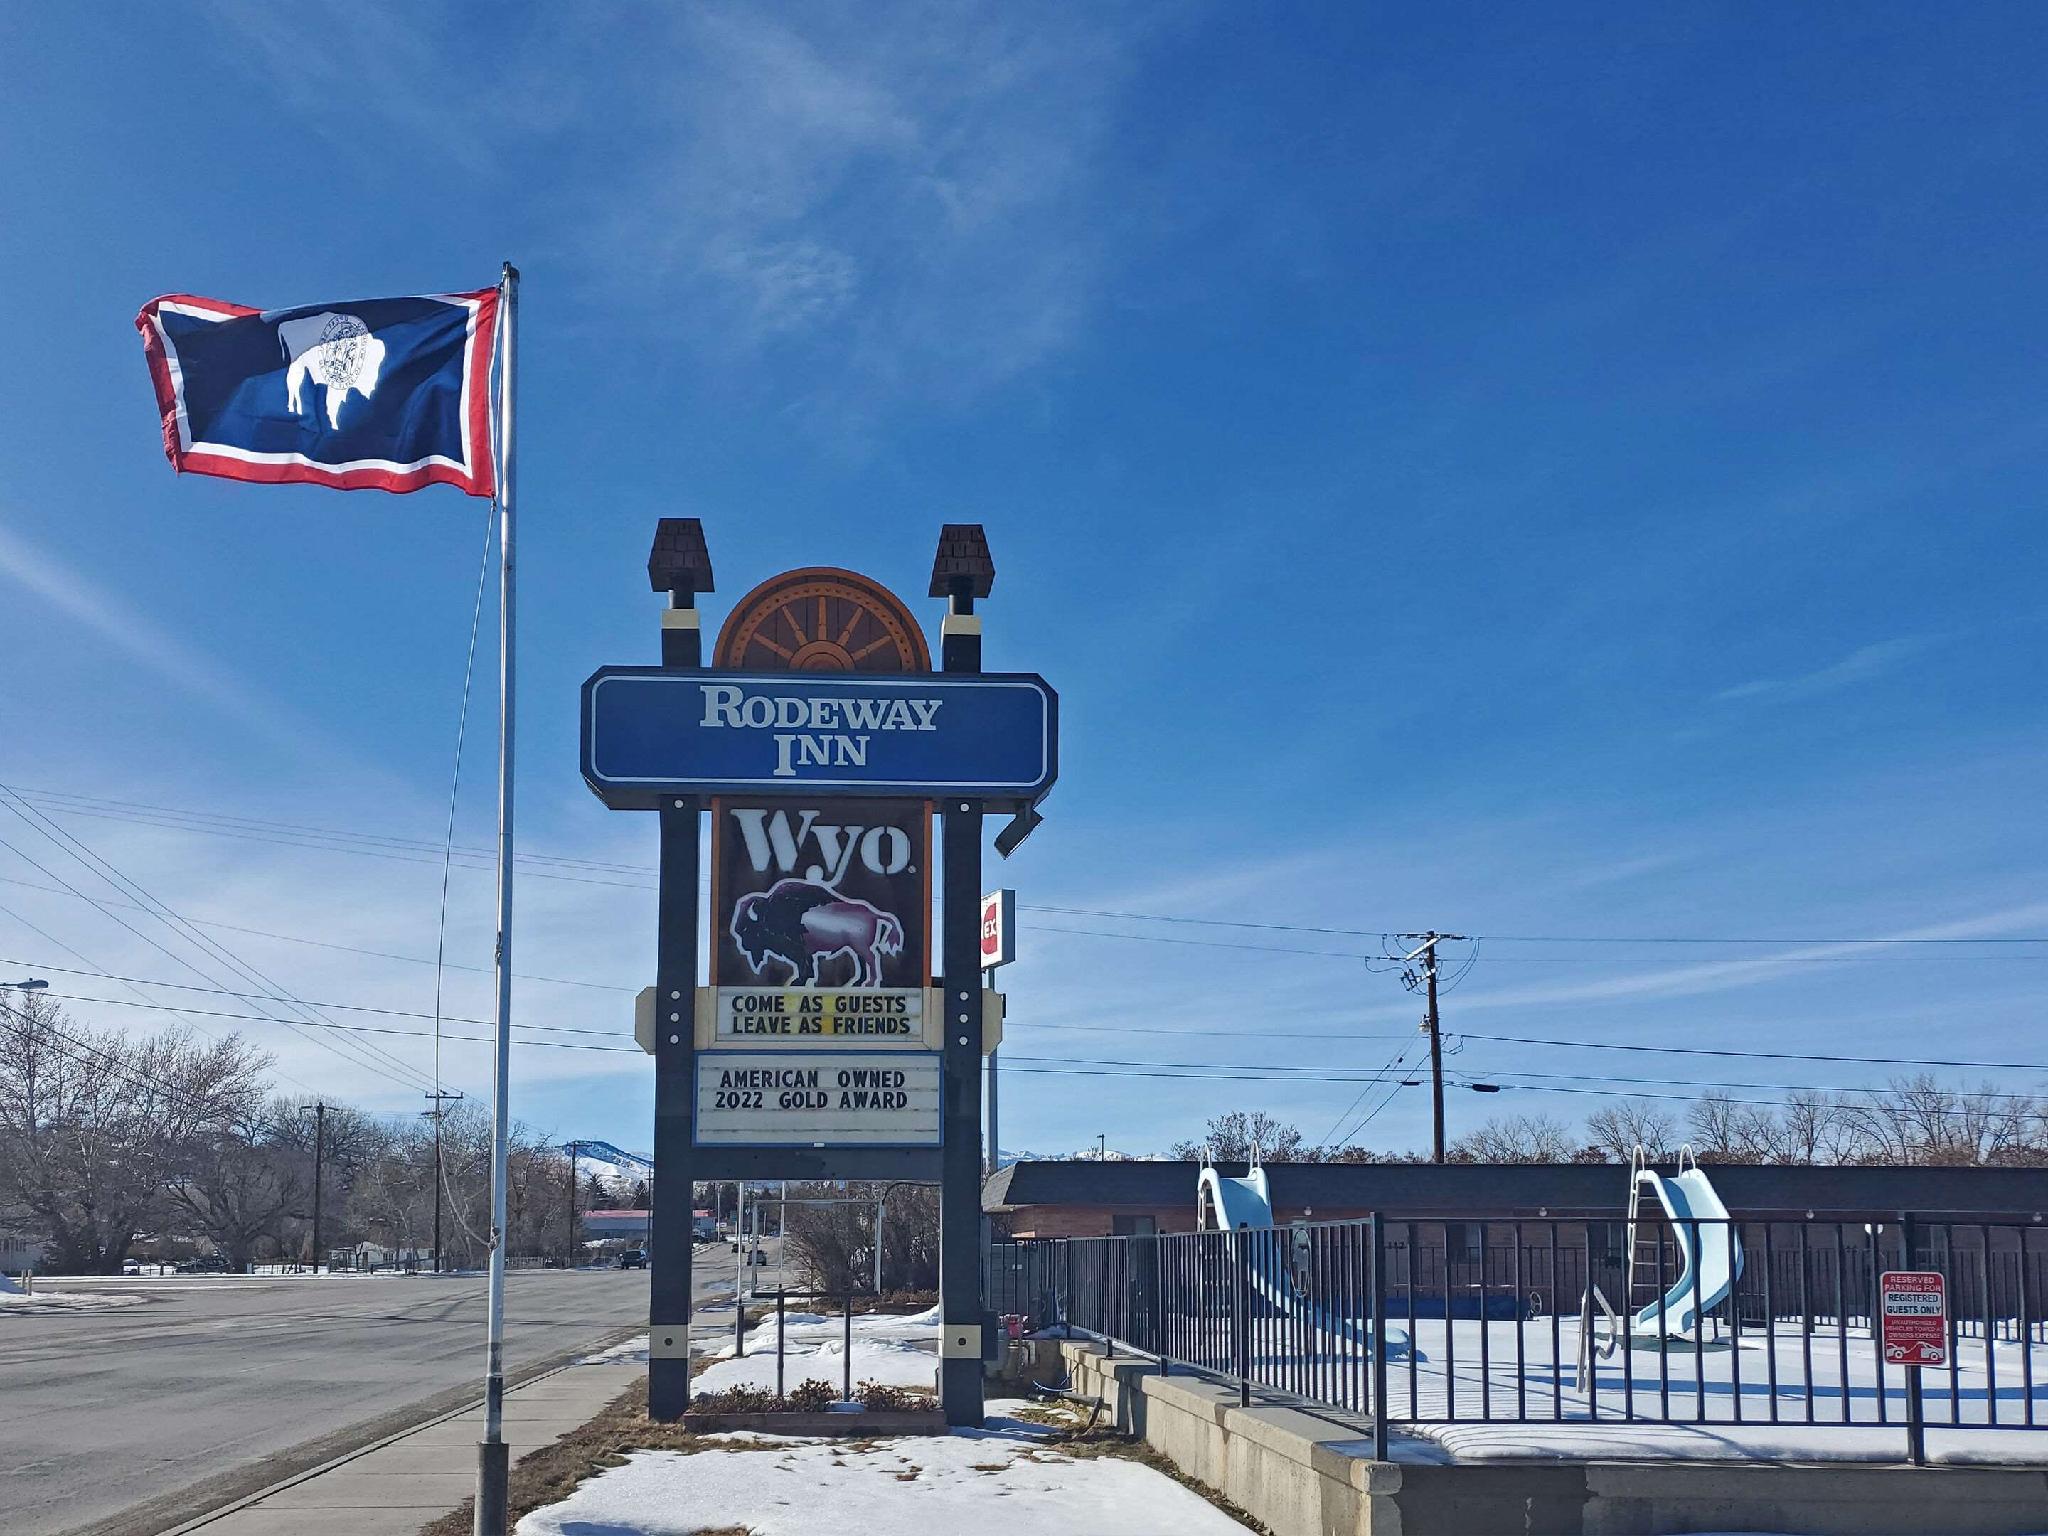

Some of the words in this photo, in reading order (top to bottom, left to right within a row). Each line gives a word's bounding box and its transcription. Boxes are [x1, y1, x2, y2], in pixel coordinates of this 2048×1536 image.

[700, 685, 943, 731] RODEWAY
[773, 734, 870, 776] INN
[731, 995, 785, 1013] COME
[799, 995, 823, 1013] AS
[835, 995, 906, 1013] GUESTS
[733, 1016, 791, 1034] LEAVE
[799, 1016, 822, 1034] AS
[833, 1017, 911, 1034] FRIENDS
[720, 1070, 818, 1088] AMERICAN
[838, 1071, 905, 1088] OWNED
[715, 1092, 763, 1109] 2022
[779, 1092, 828, 1109] GOLD
[839, 1092, 908, 1109] AWARD
[1890, 1276, 1935, 1284] RESERVED
[1888, 1293, 1938, 1303] REGISTERED
[1886, 1305, 1919, 1314] GUESTS
[1920, 1306, 1941, 1314] ONLY
